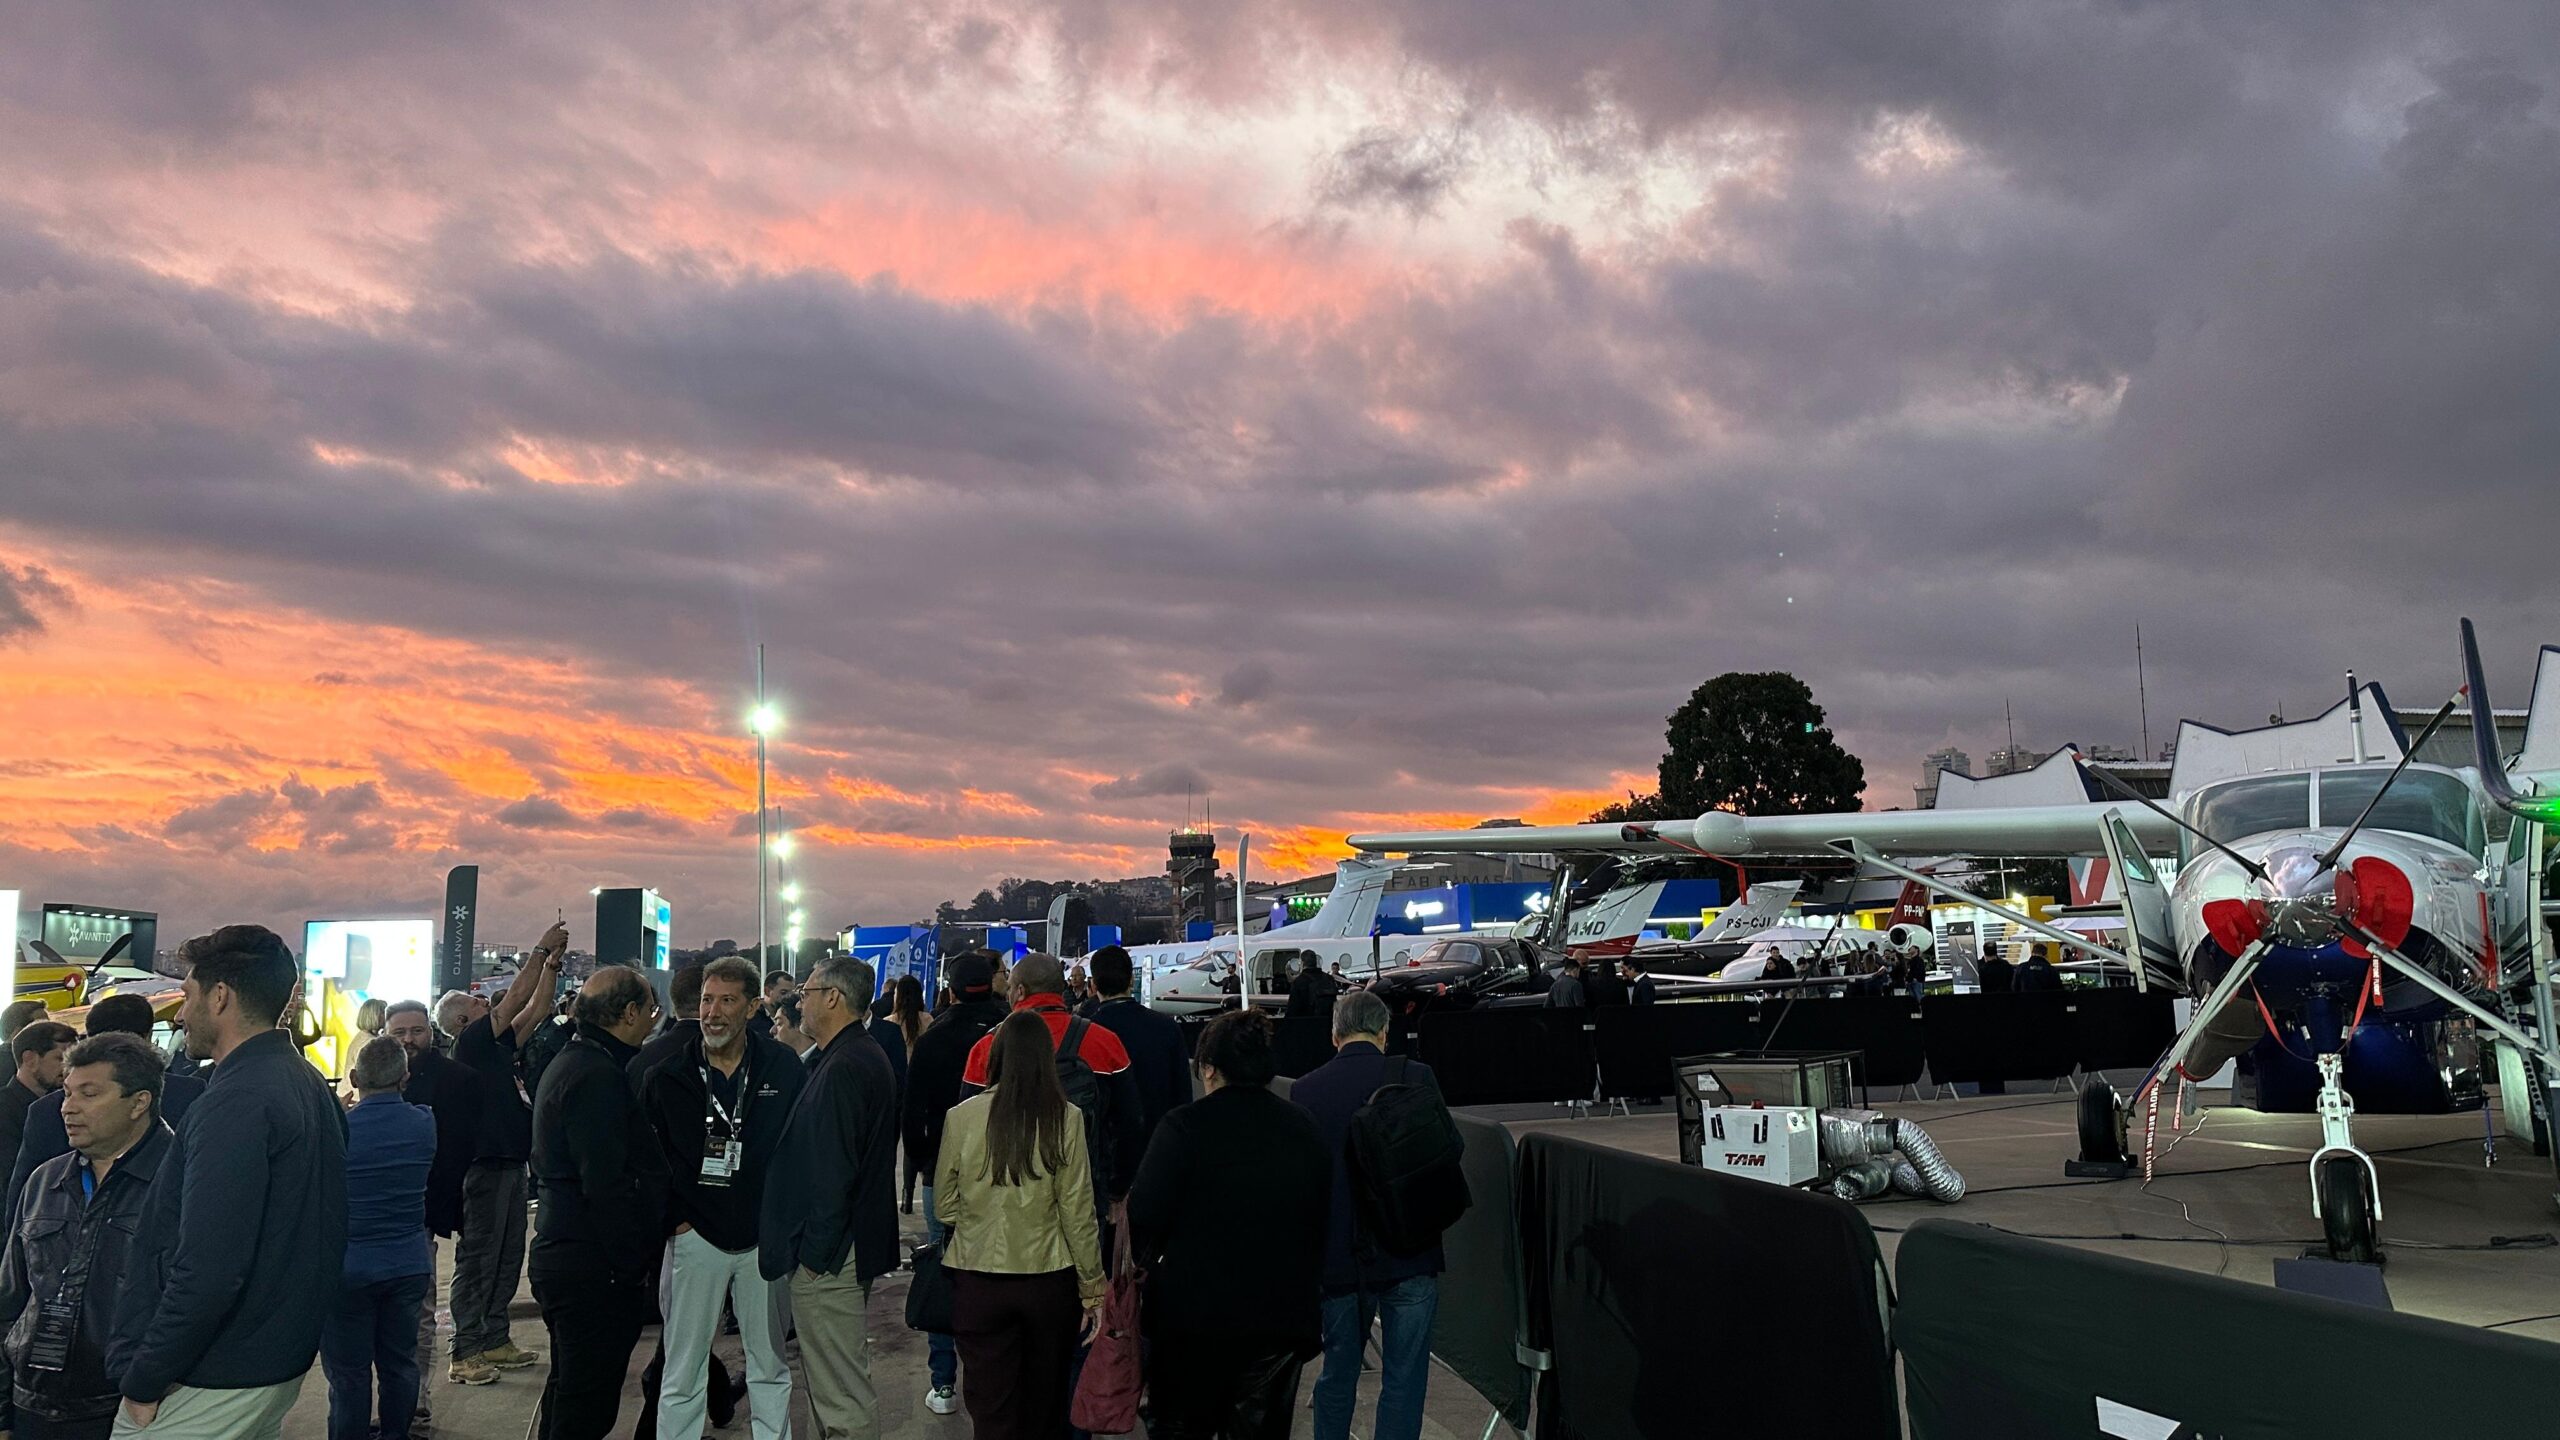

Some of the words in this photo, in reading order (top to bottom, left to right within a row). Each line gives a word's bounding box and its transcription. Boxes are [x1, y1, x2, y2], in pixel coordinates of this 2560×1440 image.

[1392, 875, 1429, 888] FAB
[79, 931, 112, 943] AVANTTO
[453, 921, 463, 976] AVANTTO
[2146, 1115, 2156, 1149] BEFORE
[1725, 1153, 1766, 1166] TAM
